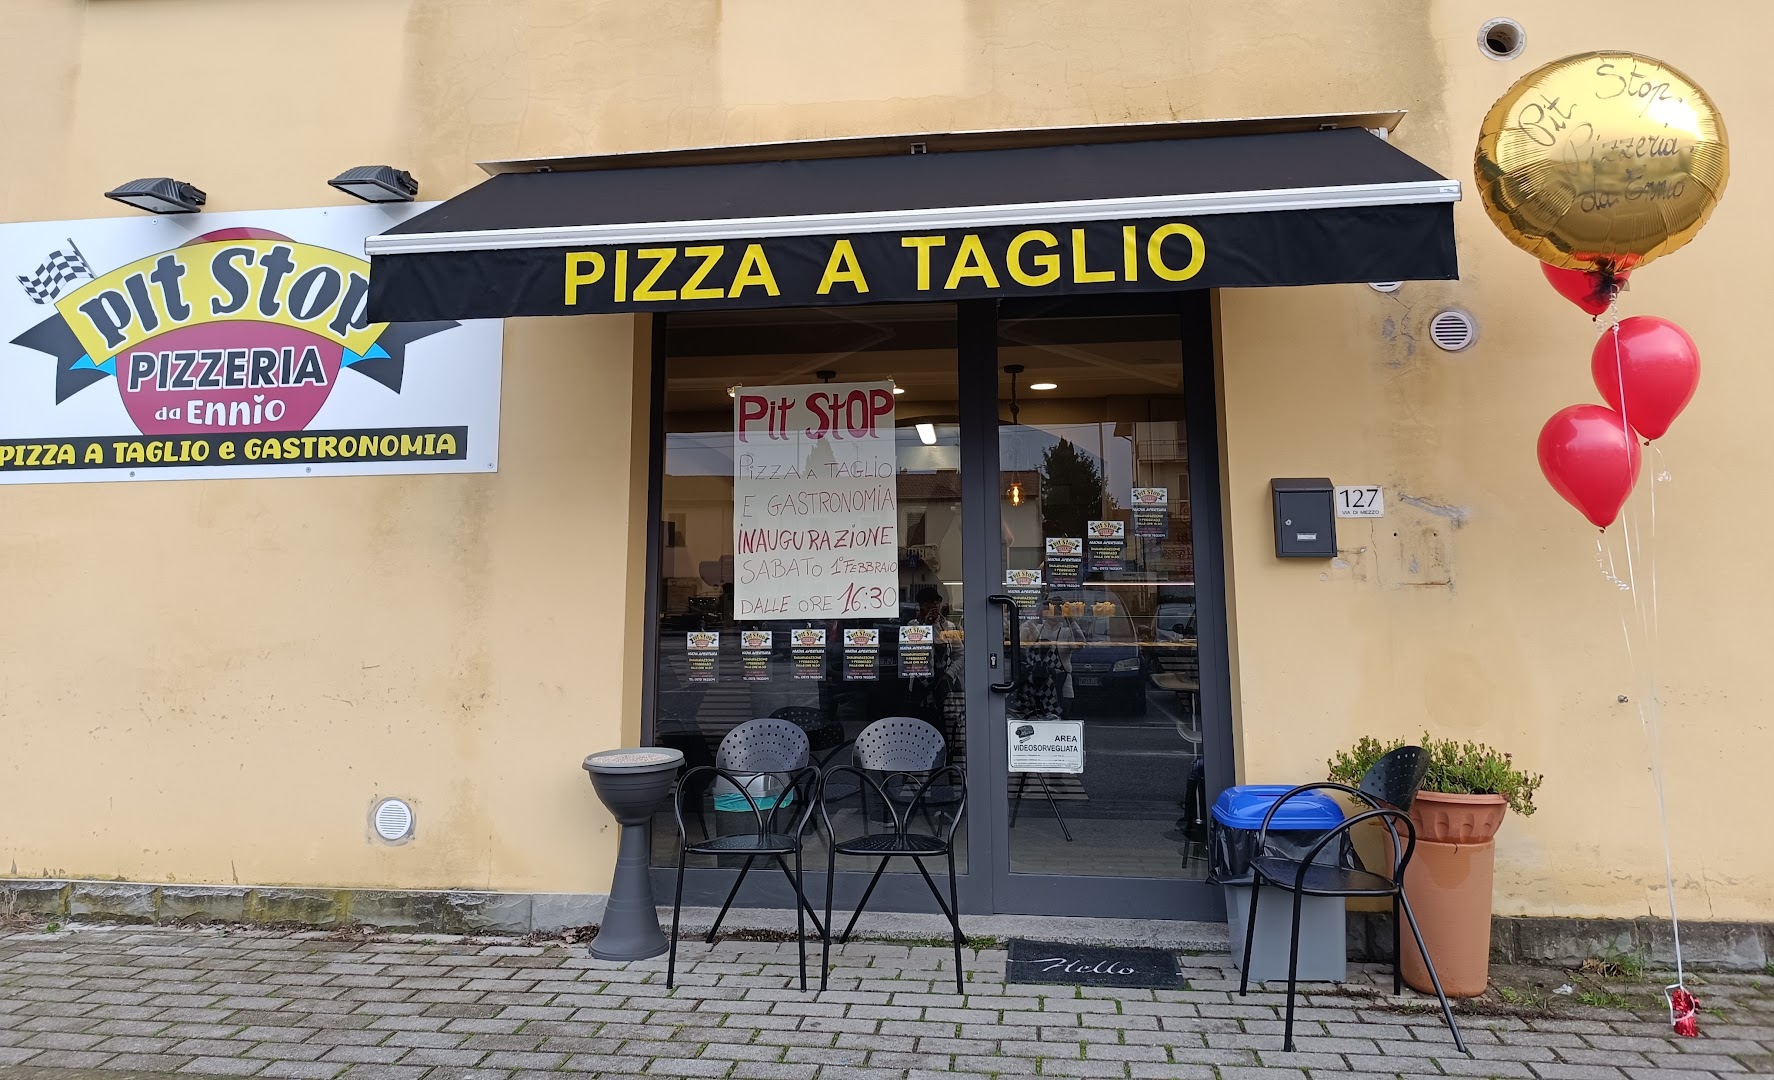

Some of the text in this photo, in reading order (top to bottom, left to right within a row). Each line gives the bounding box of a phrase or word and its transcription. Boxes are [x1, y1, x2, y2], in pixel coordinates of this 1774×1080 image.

[1518, 95, 1578, 146] Pit
[564, 223, 1206, 305] PIZZA A TAGLIO
[129, 348, 326, 390] PIZZERIA
[155, 395, 286, 427] da Ennio
[738, 395, 796, 443] Pit
[0, 433, 457, 466] PIZZA A TAGLIO e GASTRONOMIA
[742, 495, 756, 518] E
[1339, 489, 1379, 508] 127
[741, 595, 791, 615] DALLE
[837, 582, 897, 615] 16:30
[1033, 957, 1136, 975] Hello
